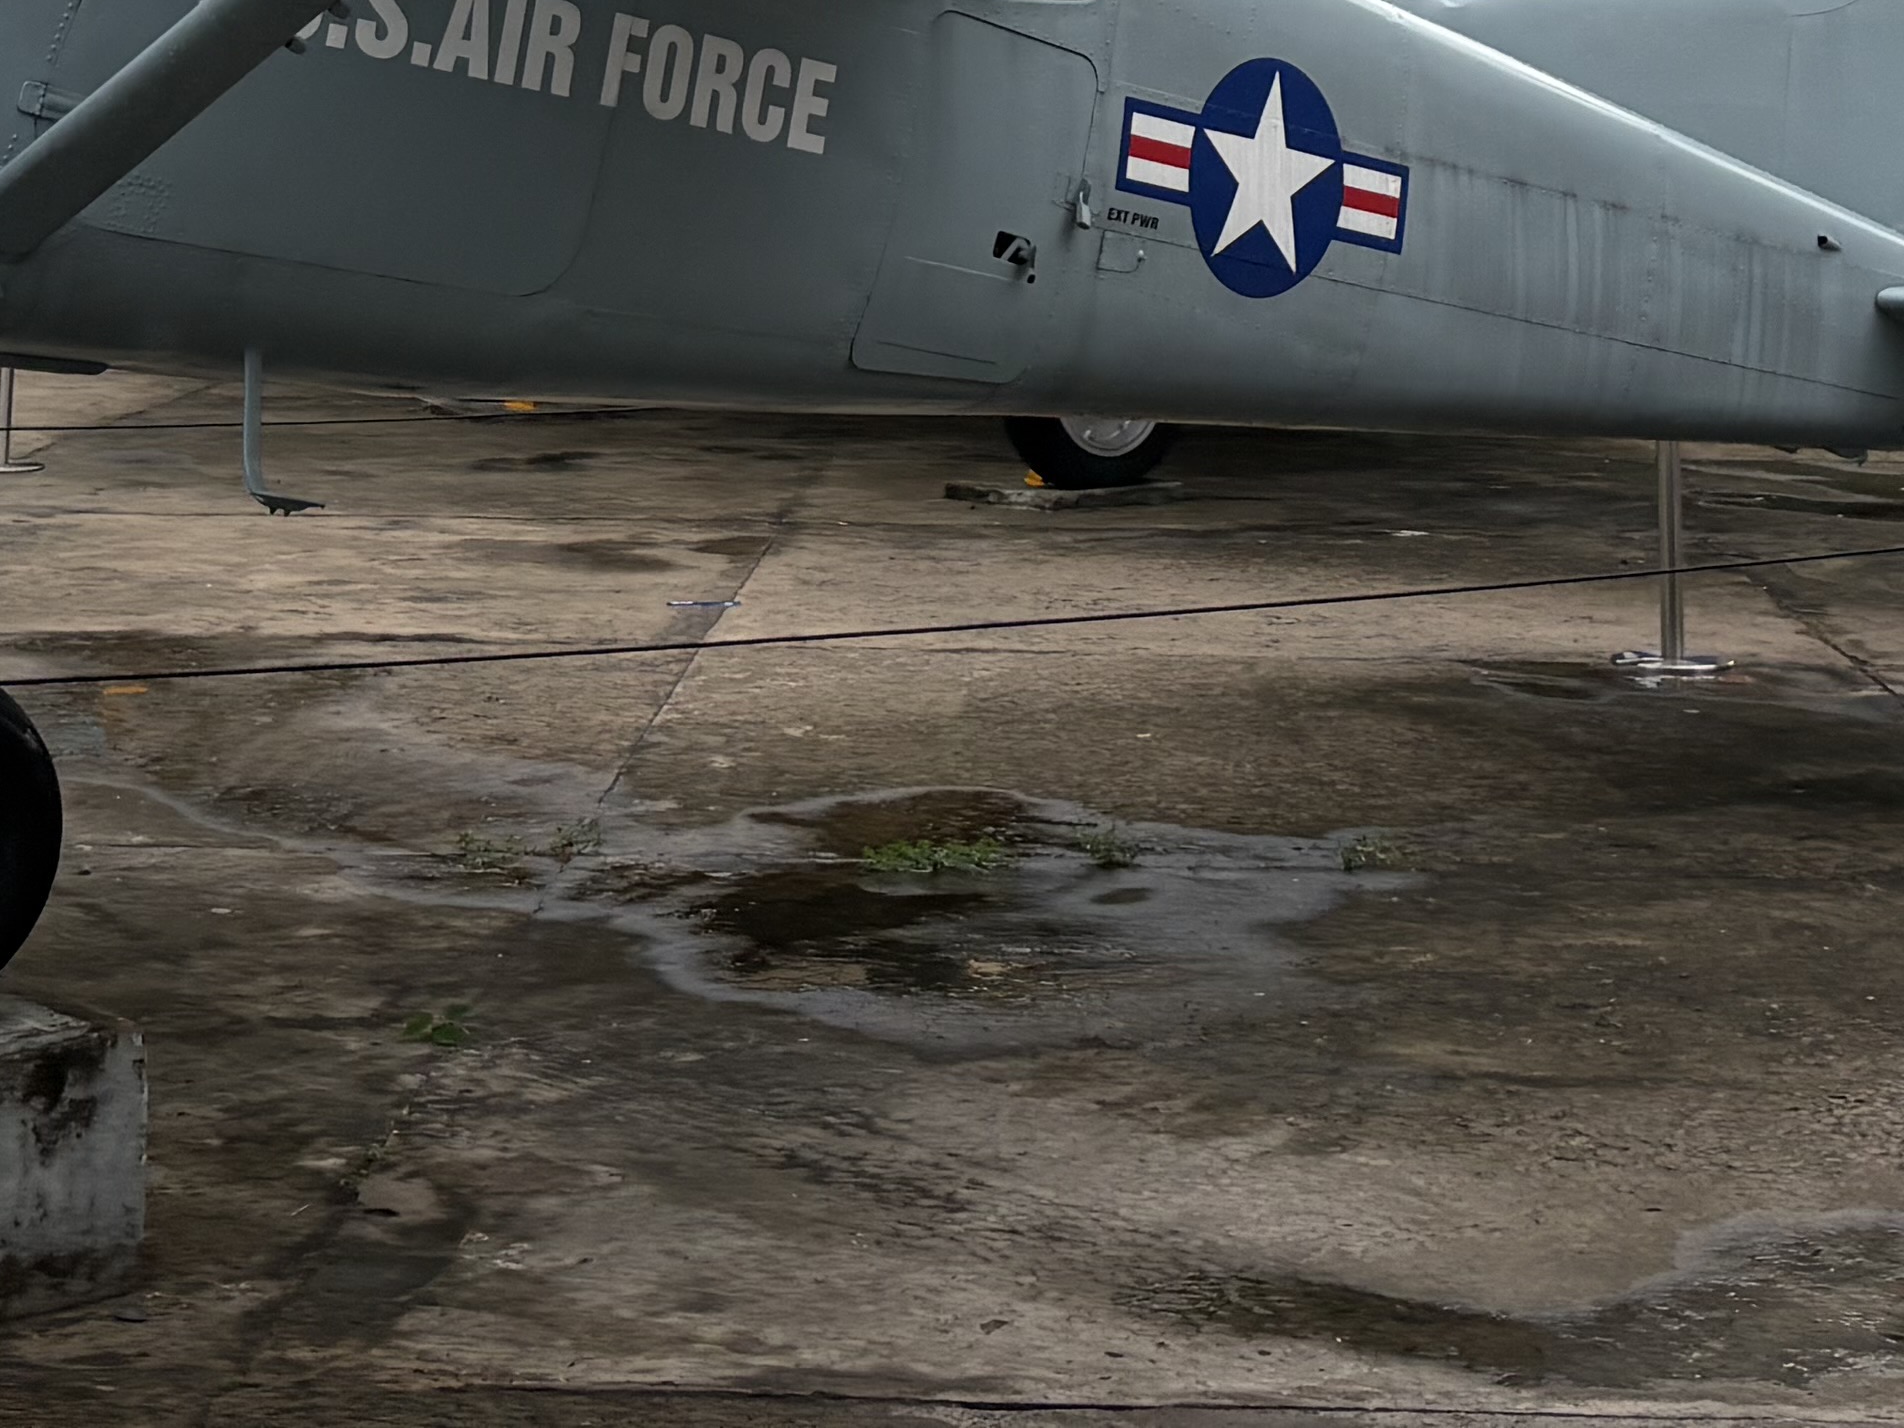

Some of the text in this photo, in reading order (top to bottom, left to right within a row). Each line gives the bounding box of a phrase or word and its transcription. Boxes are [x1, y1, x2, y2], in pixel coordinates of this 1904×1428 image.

[600, 12, 838, 155] FORCE
[1107, 207, 1159, 231] EXT PWR
